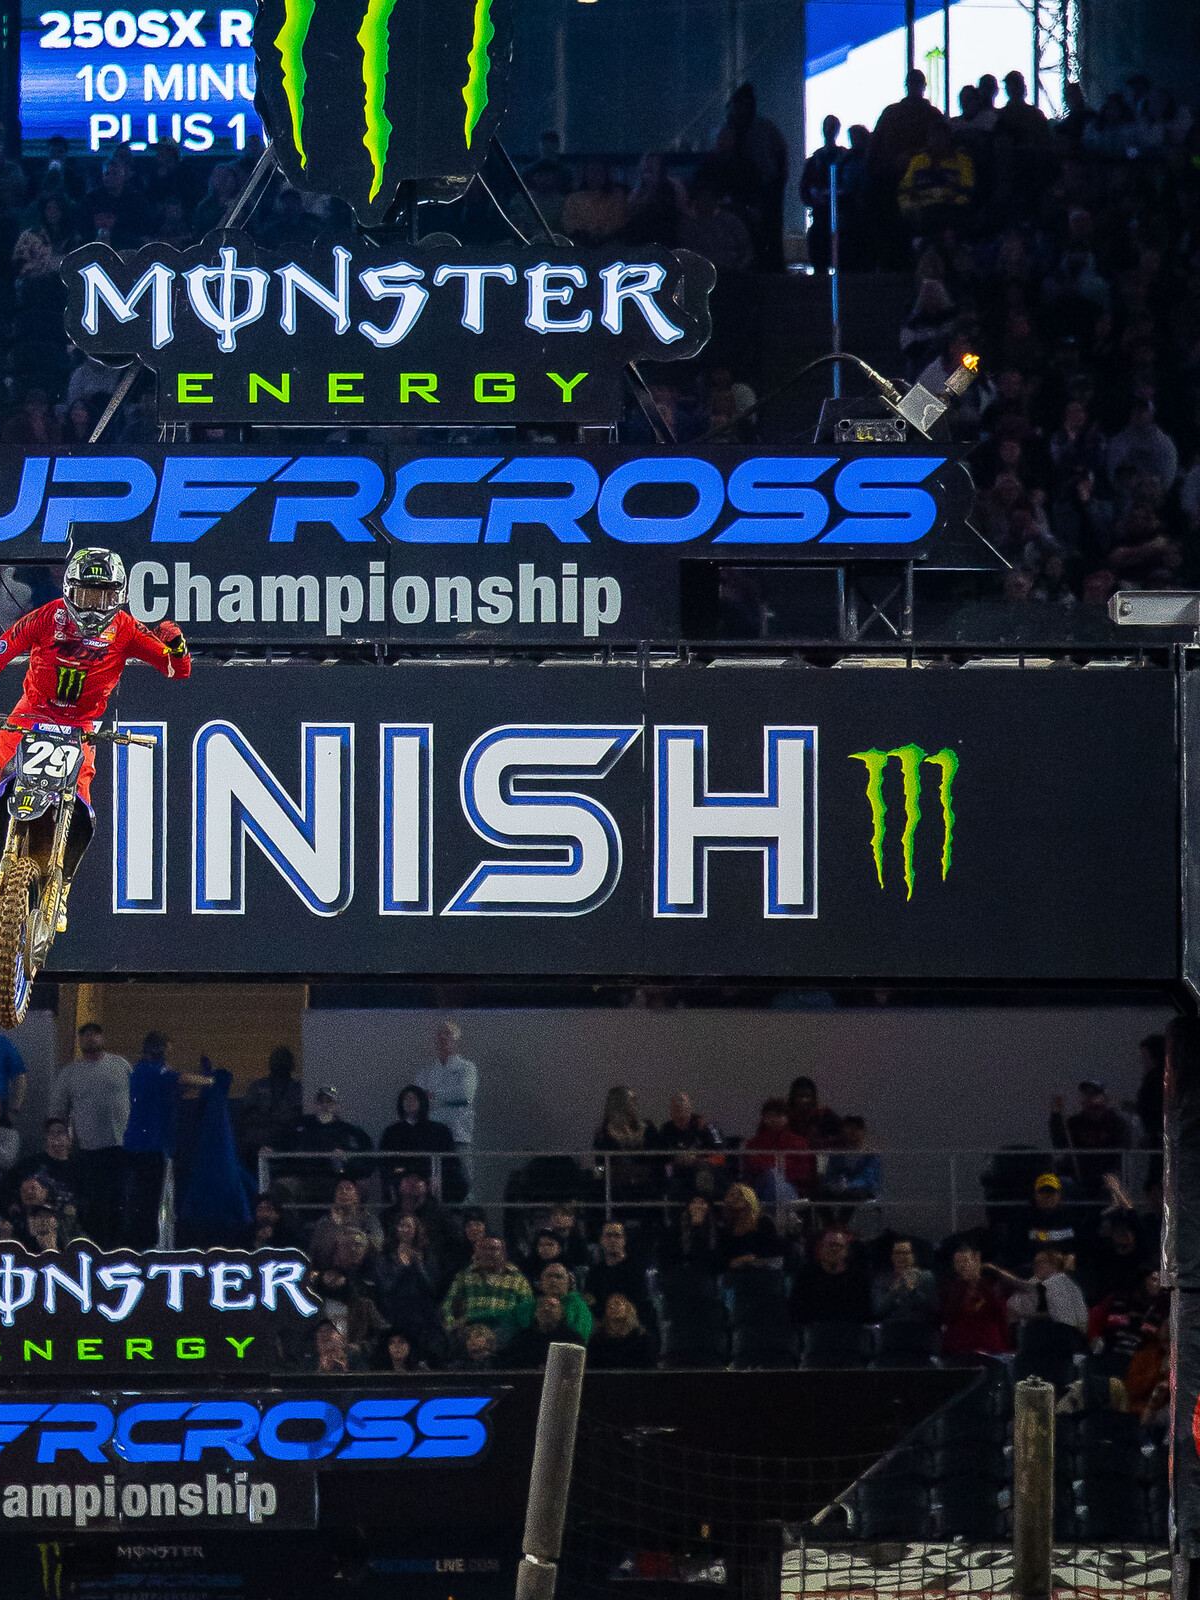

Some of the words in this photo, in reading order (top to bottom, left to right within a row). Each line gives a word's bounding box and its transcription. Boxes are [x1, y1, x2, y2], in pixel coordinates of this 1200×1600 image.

[38, 9, 207, 49] 250SX
[75, 63, 128, 102] 10
[89, 113, 215, 151] PLUS
[227, 112, 246, 150] 1
[78, 246, 686, 353] MONSTER
[177, 371, 590, 404] ENERGY
[128, 560, 623, 637] Championship
[22, 740, 81, 779] 29
[116, 1545, 206, 1560] MONSTER
